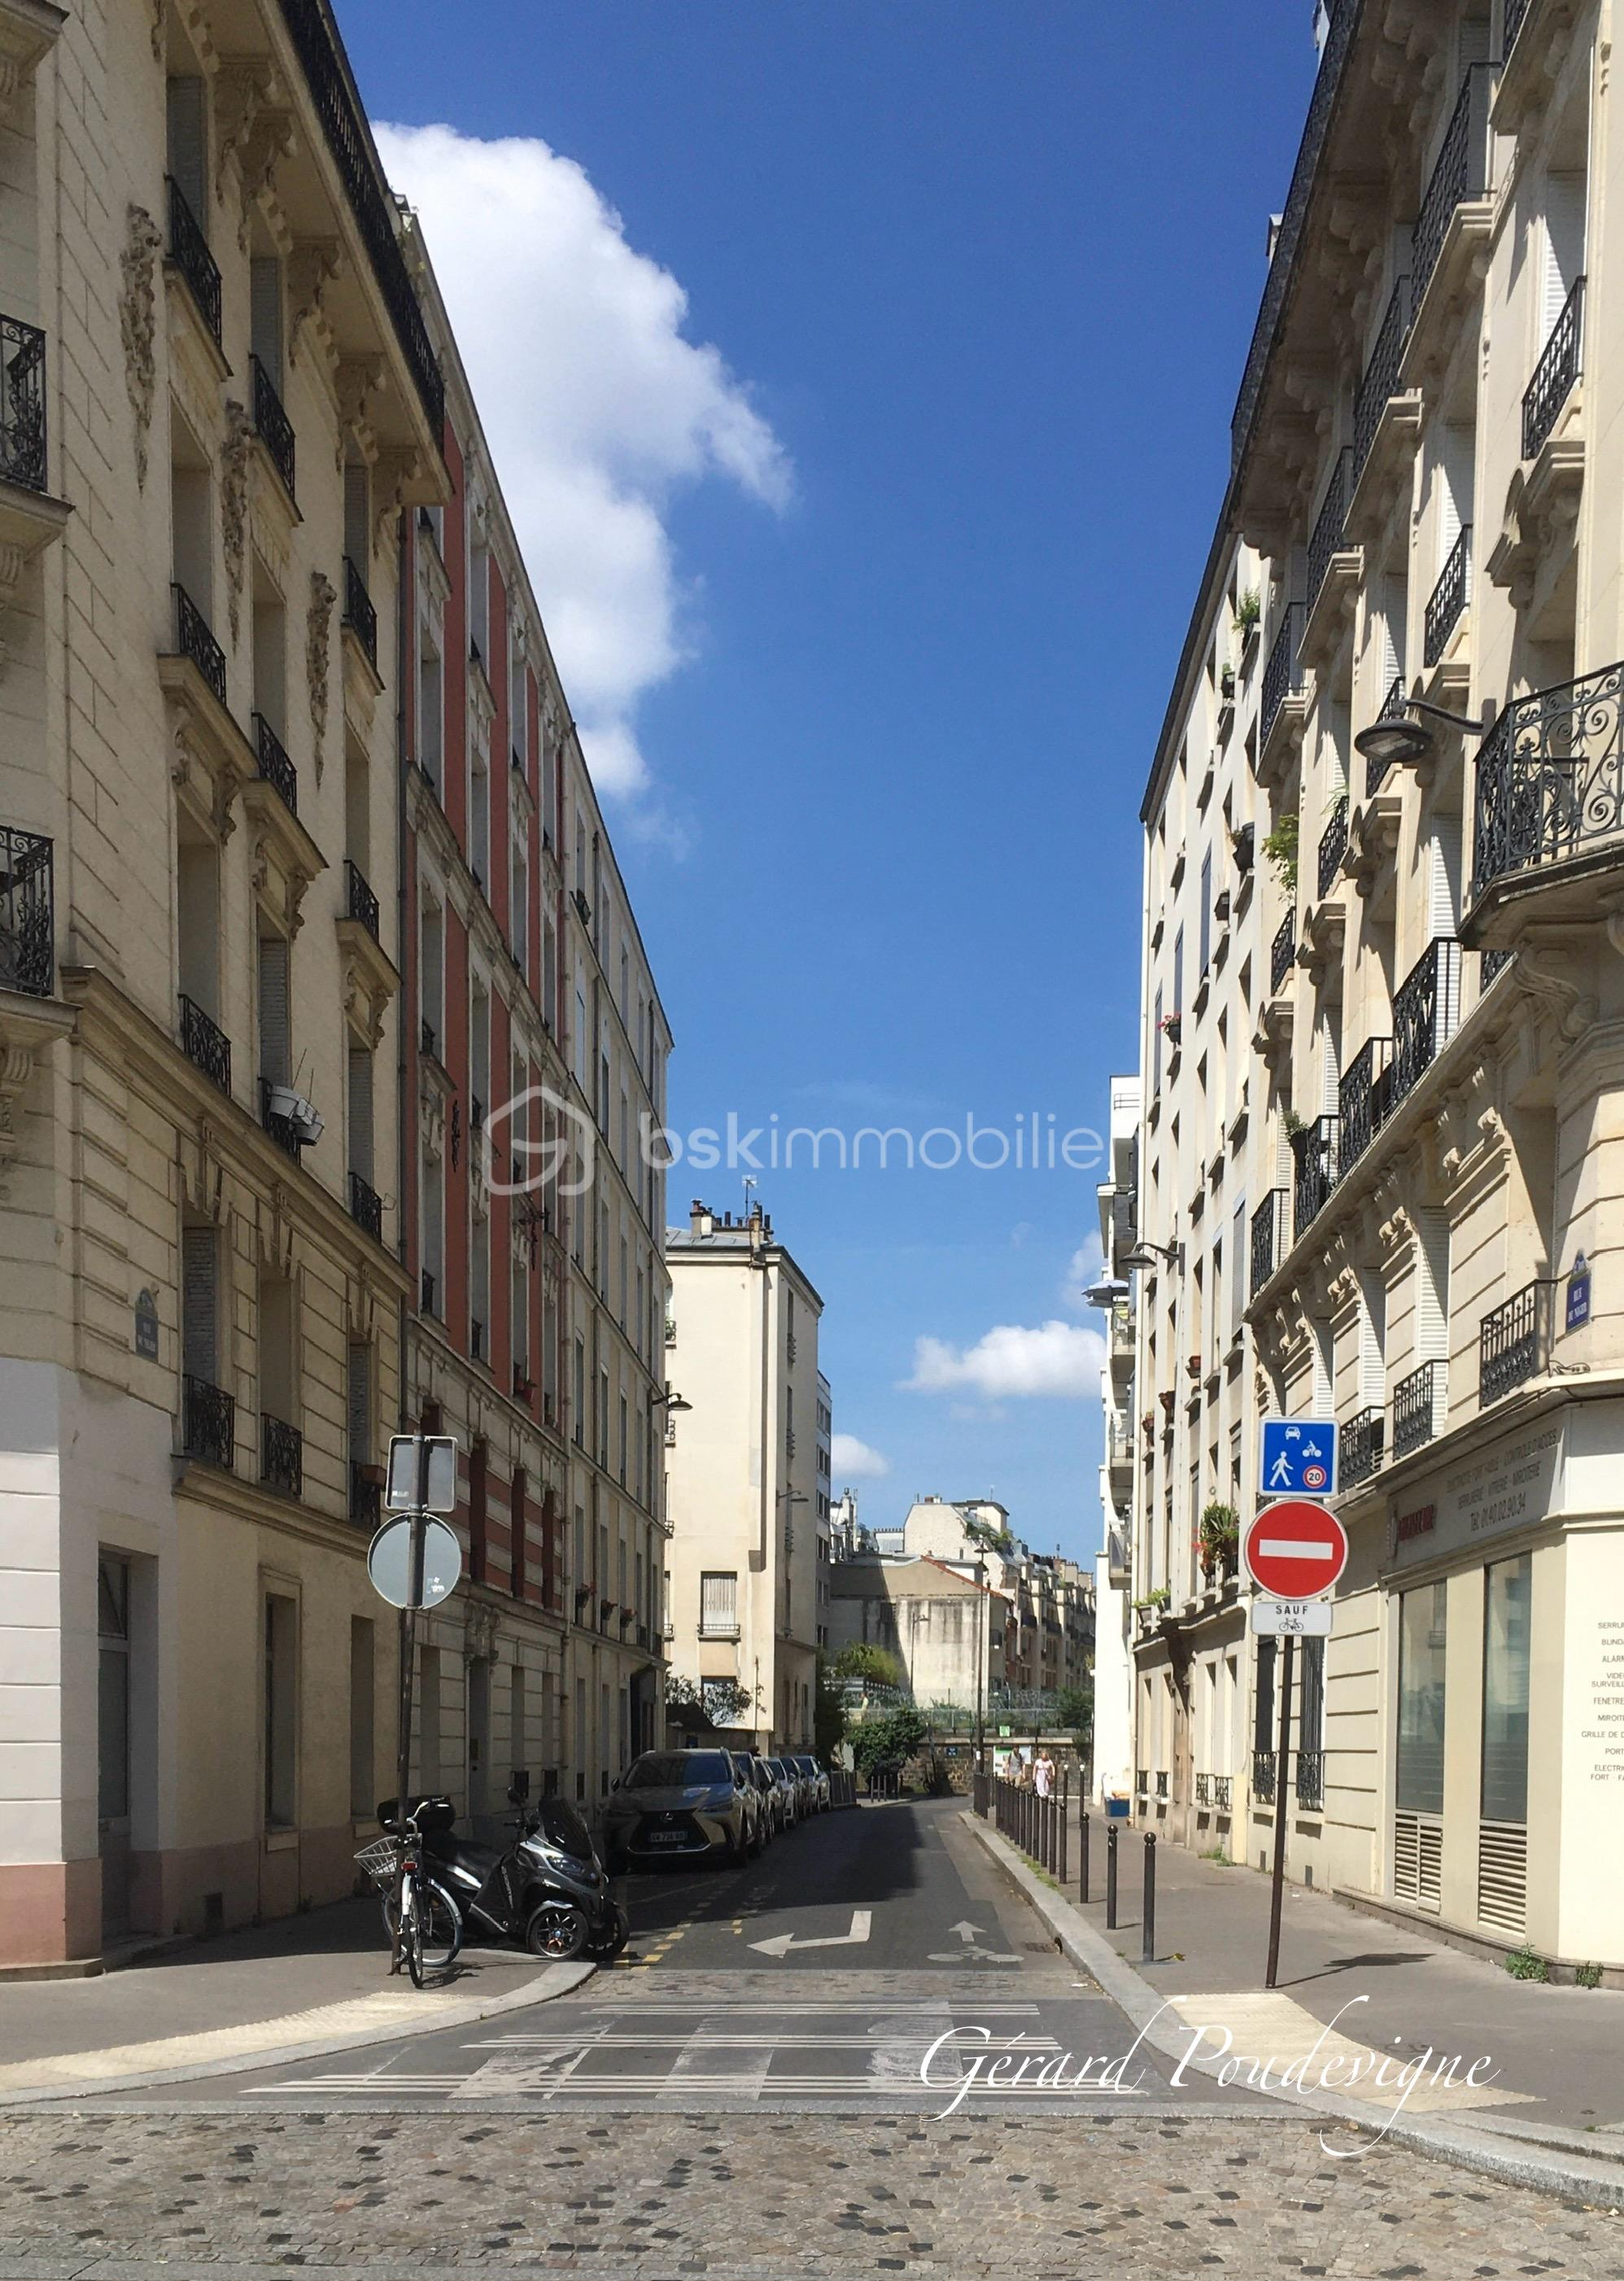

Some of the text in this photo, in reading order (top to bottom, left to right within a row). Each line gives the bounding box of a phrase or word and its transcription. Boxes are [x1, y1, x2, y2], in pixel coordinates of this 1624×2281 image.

[1308, 1472, 1321, 1481] 20
[1275, 1605, 1308, 1615] SAUF
[1590, 1773, 1609, 1781] FORT
